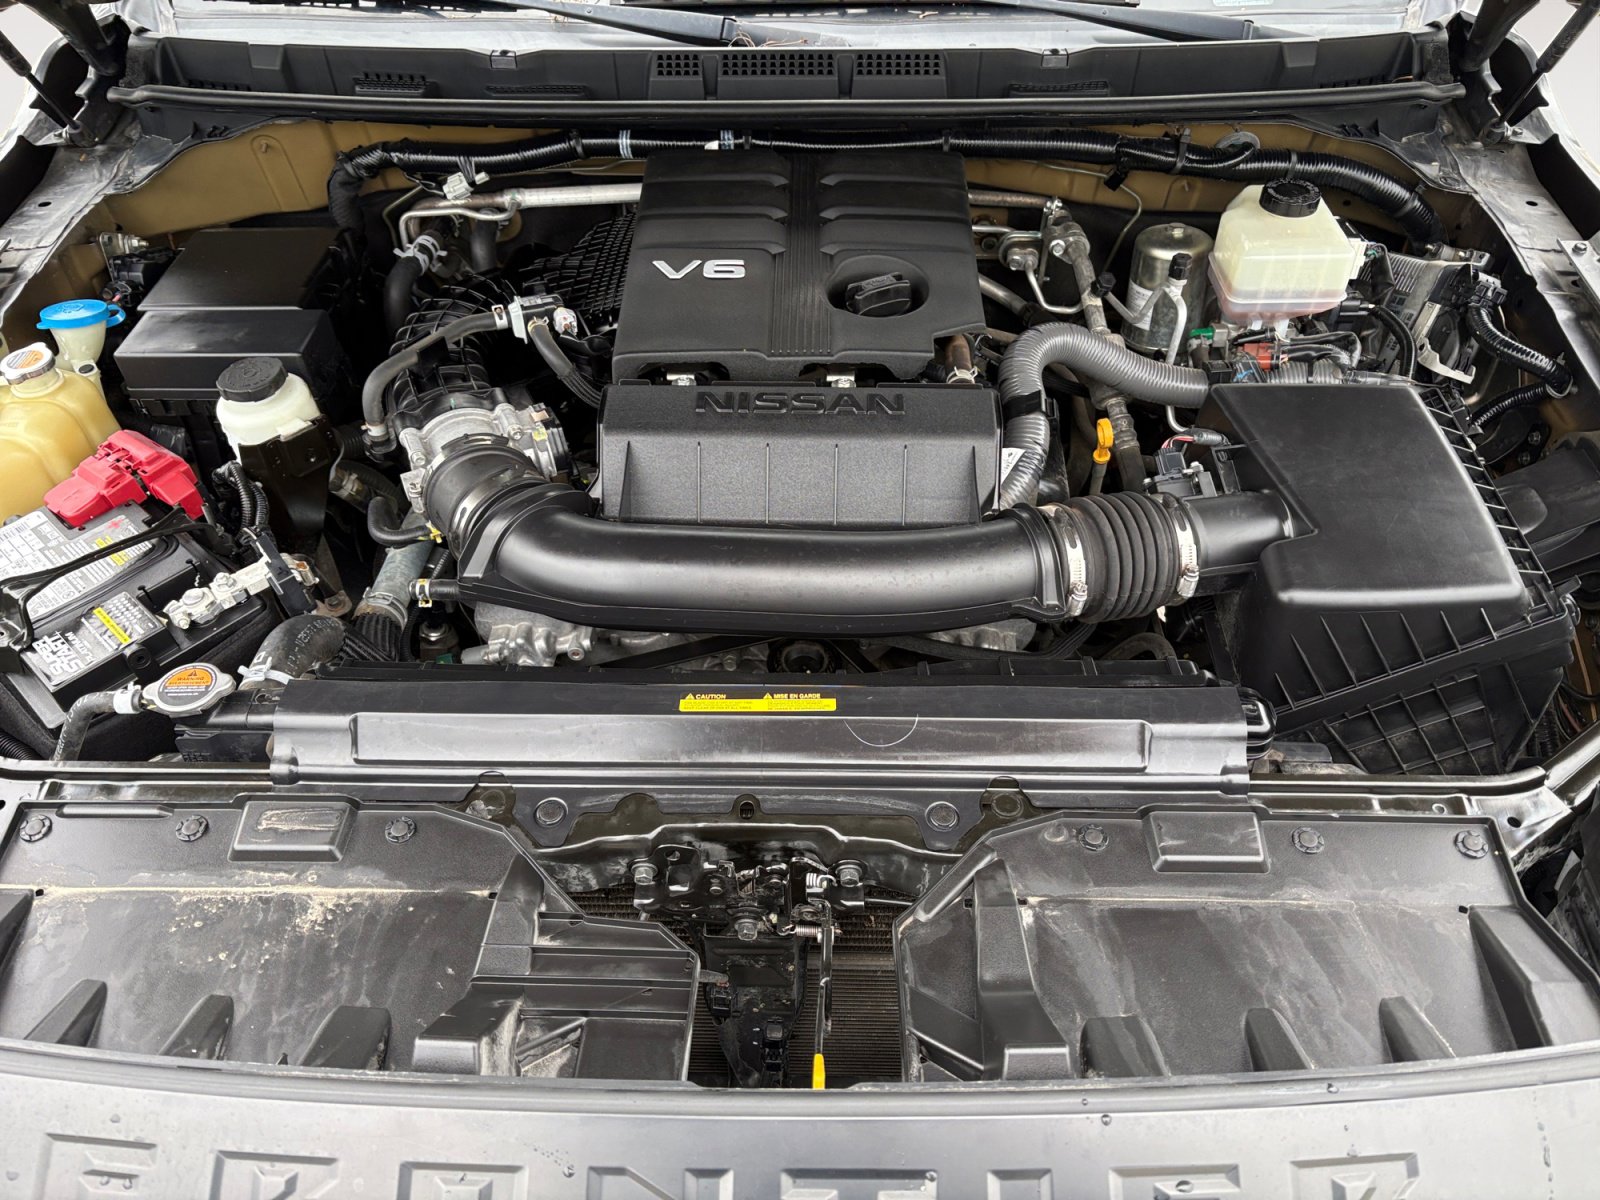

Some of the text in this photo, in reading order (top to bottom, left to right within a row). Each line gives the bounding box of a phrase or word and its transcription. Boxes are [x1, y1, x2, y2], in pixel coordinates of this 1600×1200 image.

[652, 259, 746, 280] V6
[695, 391, 905, 415] NISSAN
[32, 637, 65, 676] SUPER
[43, 635, 86, 673] START
[65, 632, 96, 663] PLATINUM
